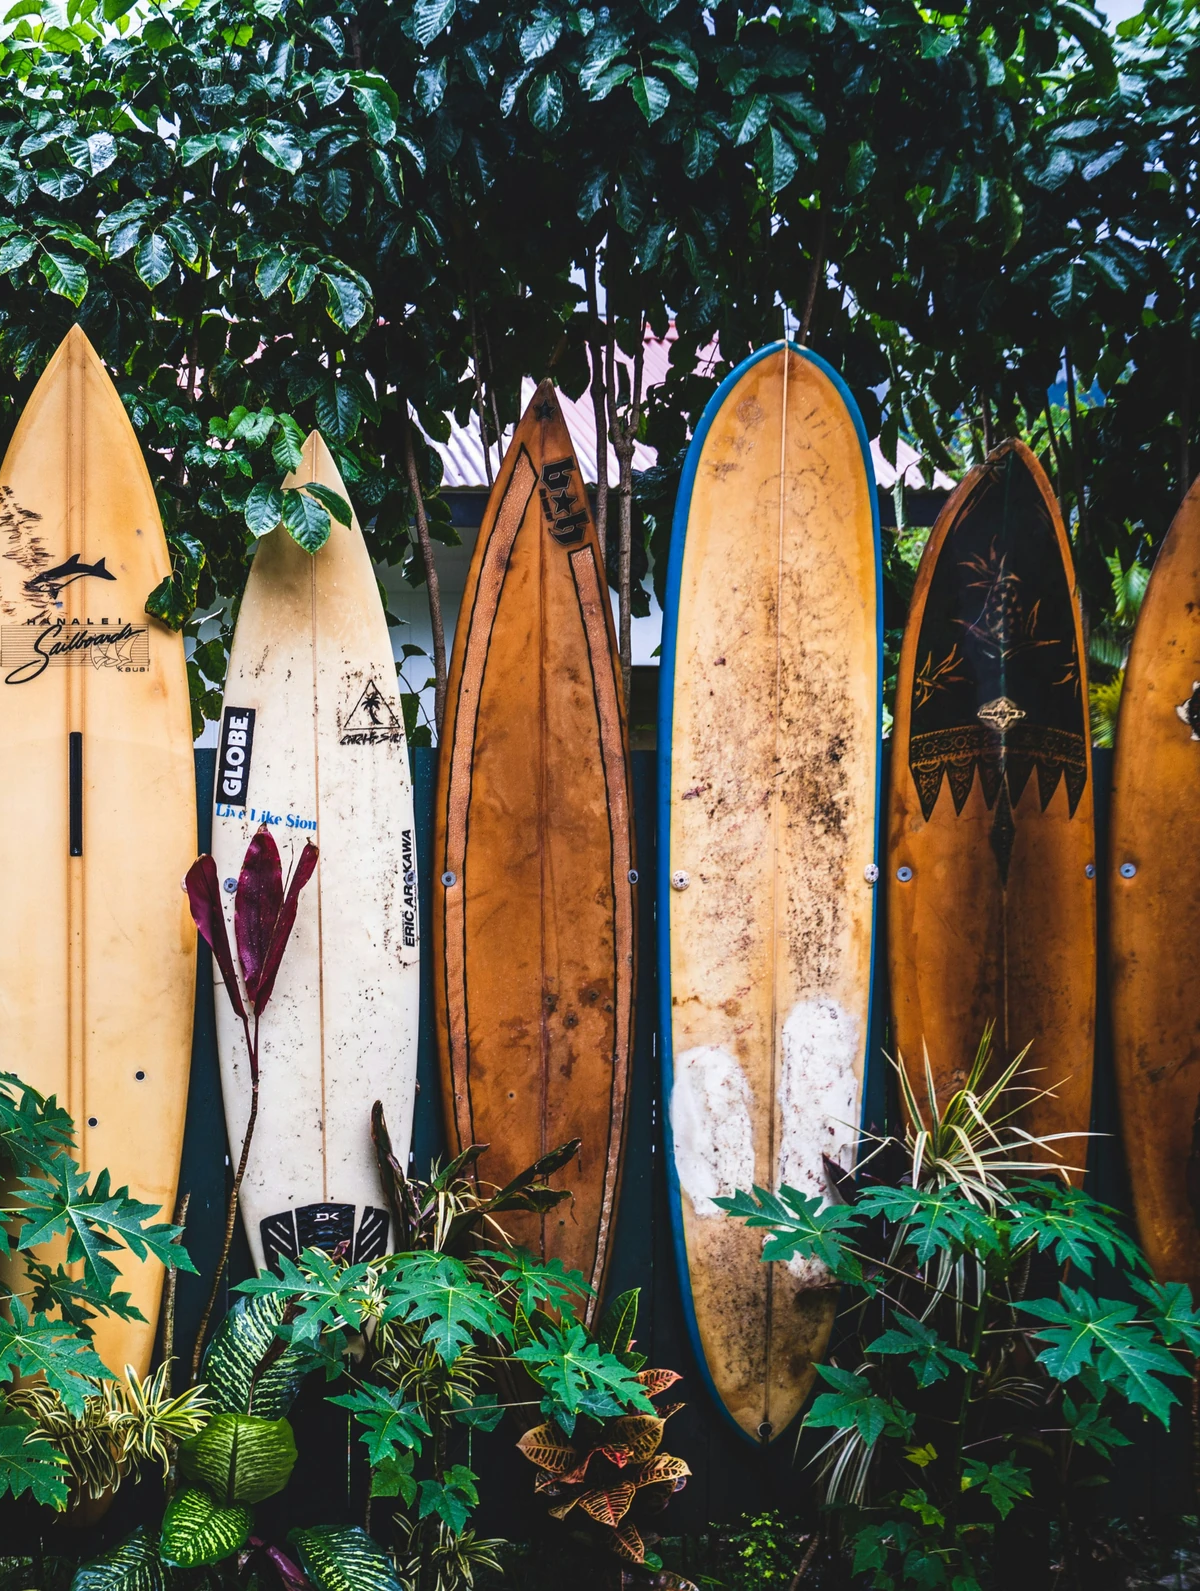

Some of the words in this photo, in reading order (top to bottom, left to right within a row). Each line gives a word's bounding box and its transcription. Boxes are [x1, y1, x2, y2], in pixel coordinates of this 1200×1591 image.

[5, 623, 147, 684] Sailboards
[250, 808, 282, 825] Like
[286, 814, 317, 831] Sion
[402, 829, 414, 909] ARKAWA
[404, 910, 415, 947] ERIC
